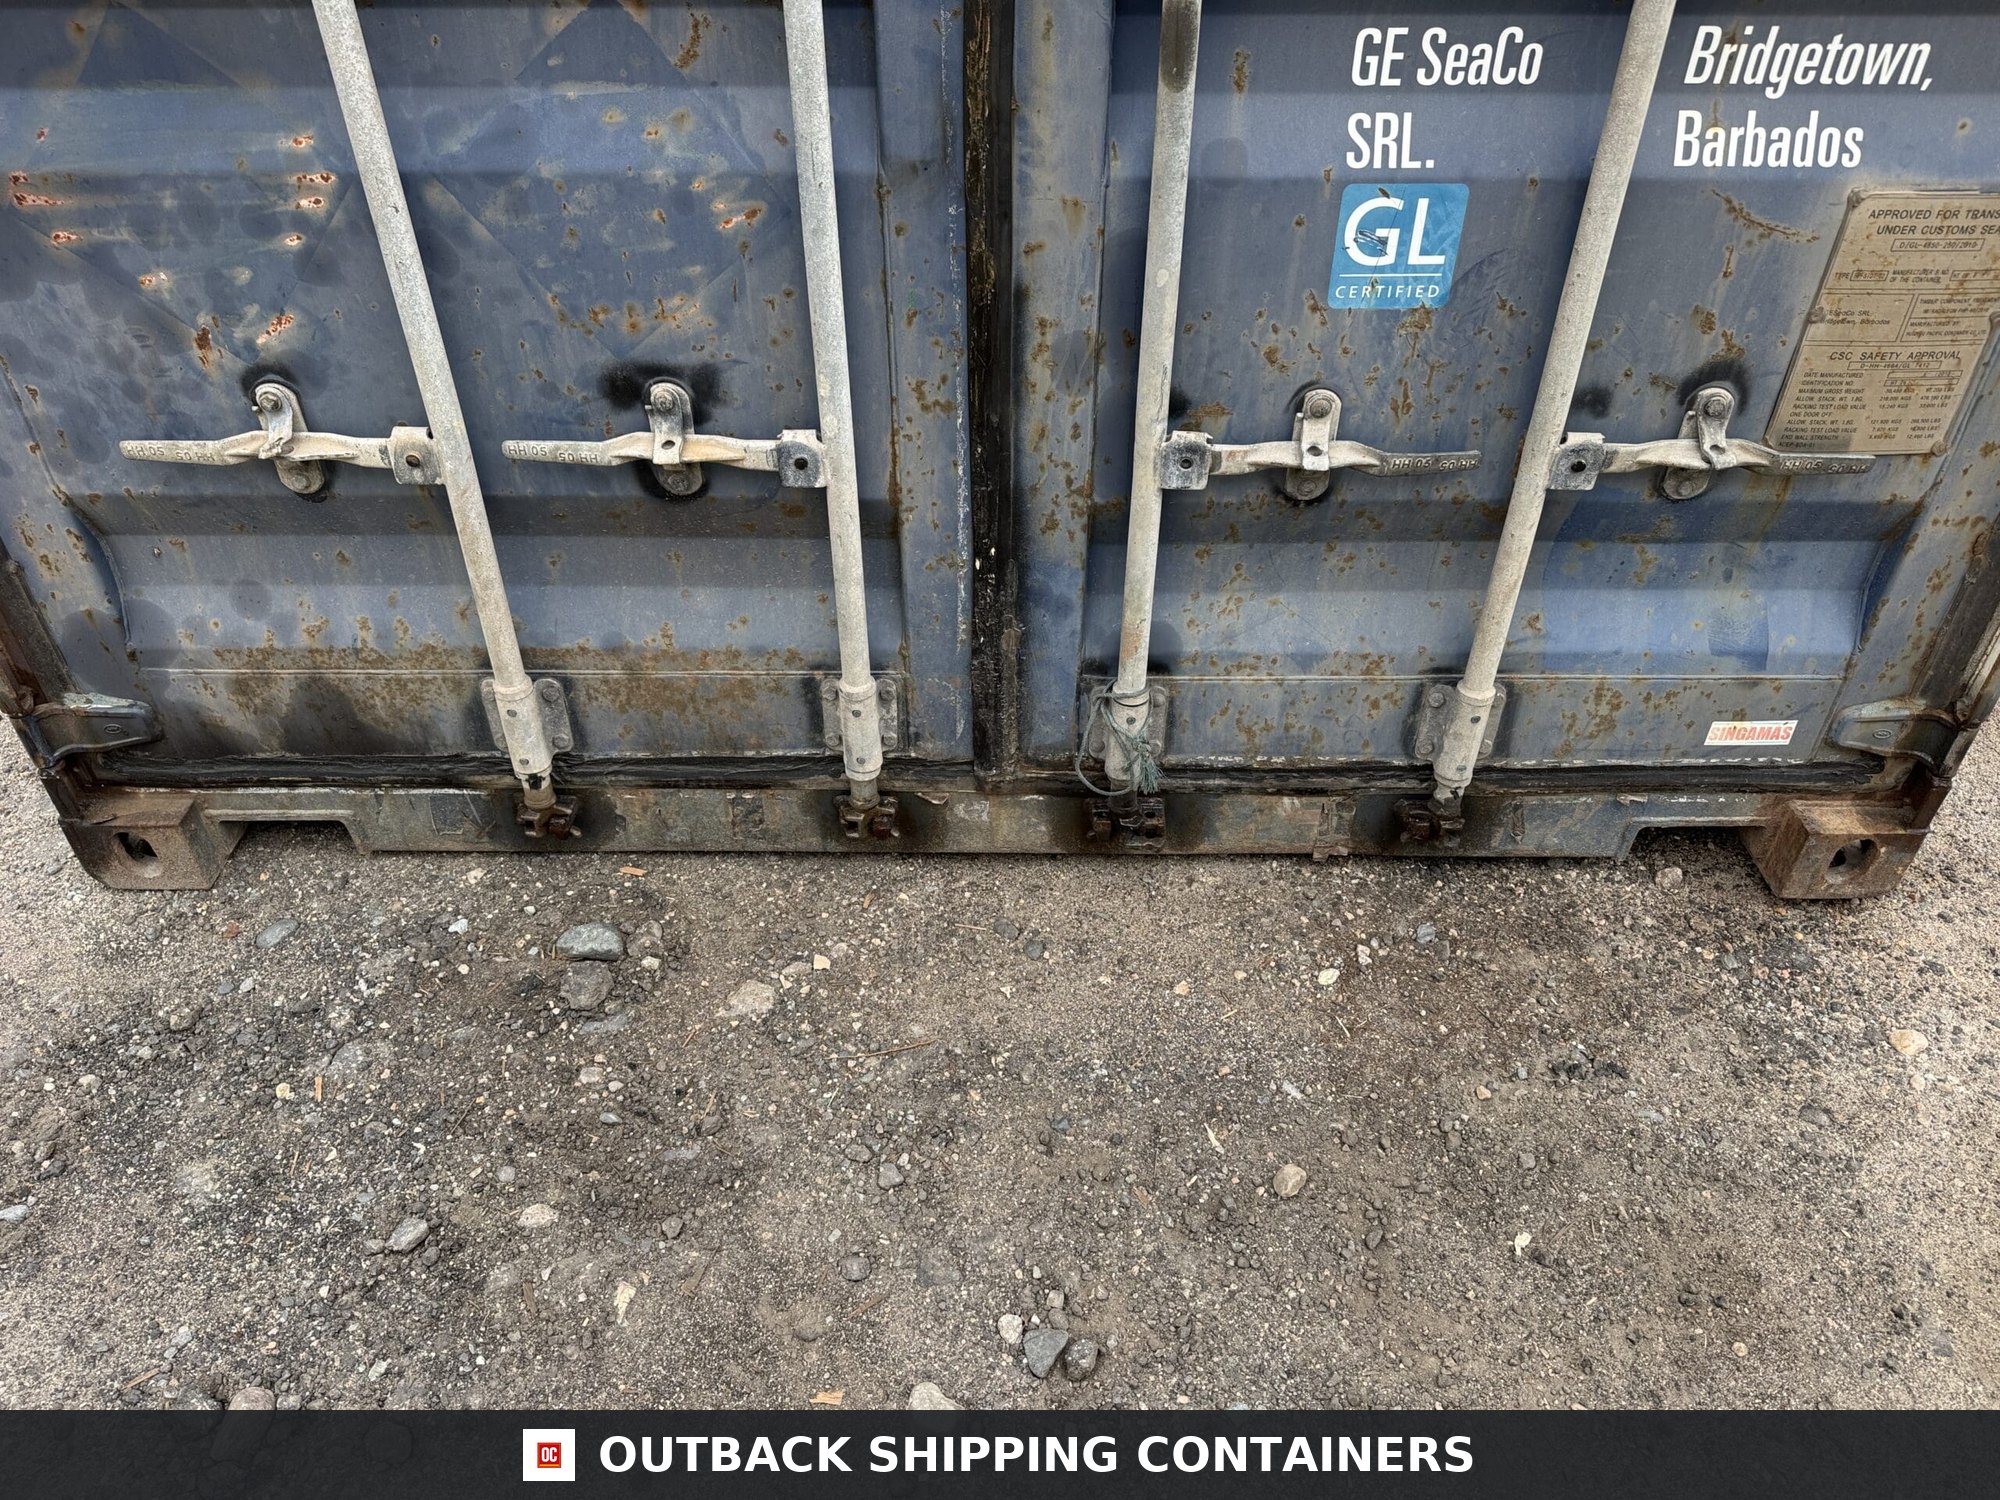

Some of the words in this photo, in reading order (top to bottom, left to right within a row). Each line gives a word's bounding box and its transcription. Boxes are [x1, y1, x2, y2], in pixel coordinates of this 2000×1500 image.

[1351, 27, 1409, 87] GE
[1416, 26, 1544, 86] SeaCo
[1683, 25, 1933, 100] Bridgetown,
[1346, 112, 1435, 169] SRL.
[1673, 110, 1864, 168] Barbados
[1868, 209, 1932, 219] APPROVED
[1936, 209, 1959, 219] FOR
[1344, 196, 1446, 266] GL
[1876, 225, 1917, 235] UNDER
[1921, 225, 1976, 235] CUSTOMS
[1335, 285, 1440, 298] CERTIFIED
[1830, 352, 1852, 360] CSC
[1859, 352, 1901, 360] SAFETY
[1907, 351, 1961, 360] APPROVAL
[507, 445, 528, 455] HH
[1391, 457, 1411, 469] HH
[1707, 726, 1794, 741] SINGAMAS
